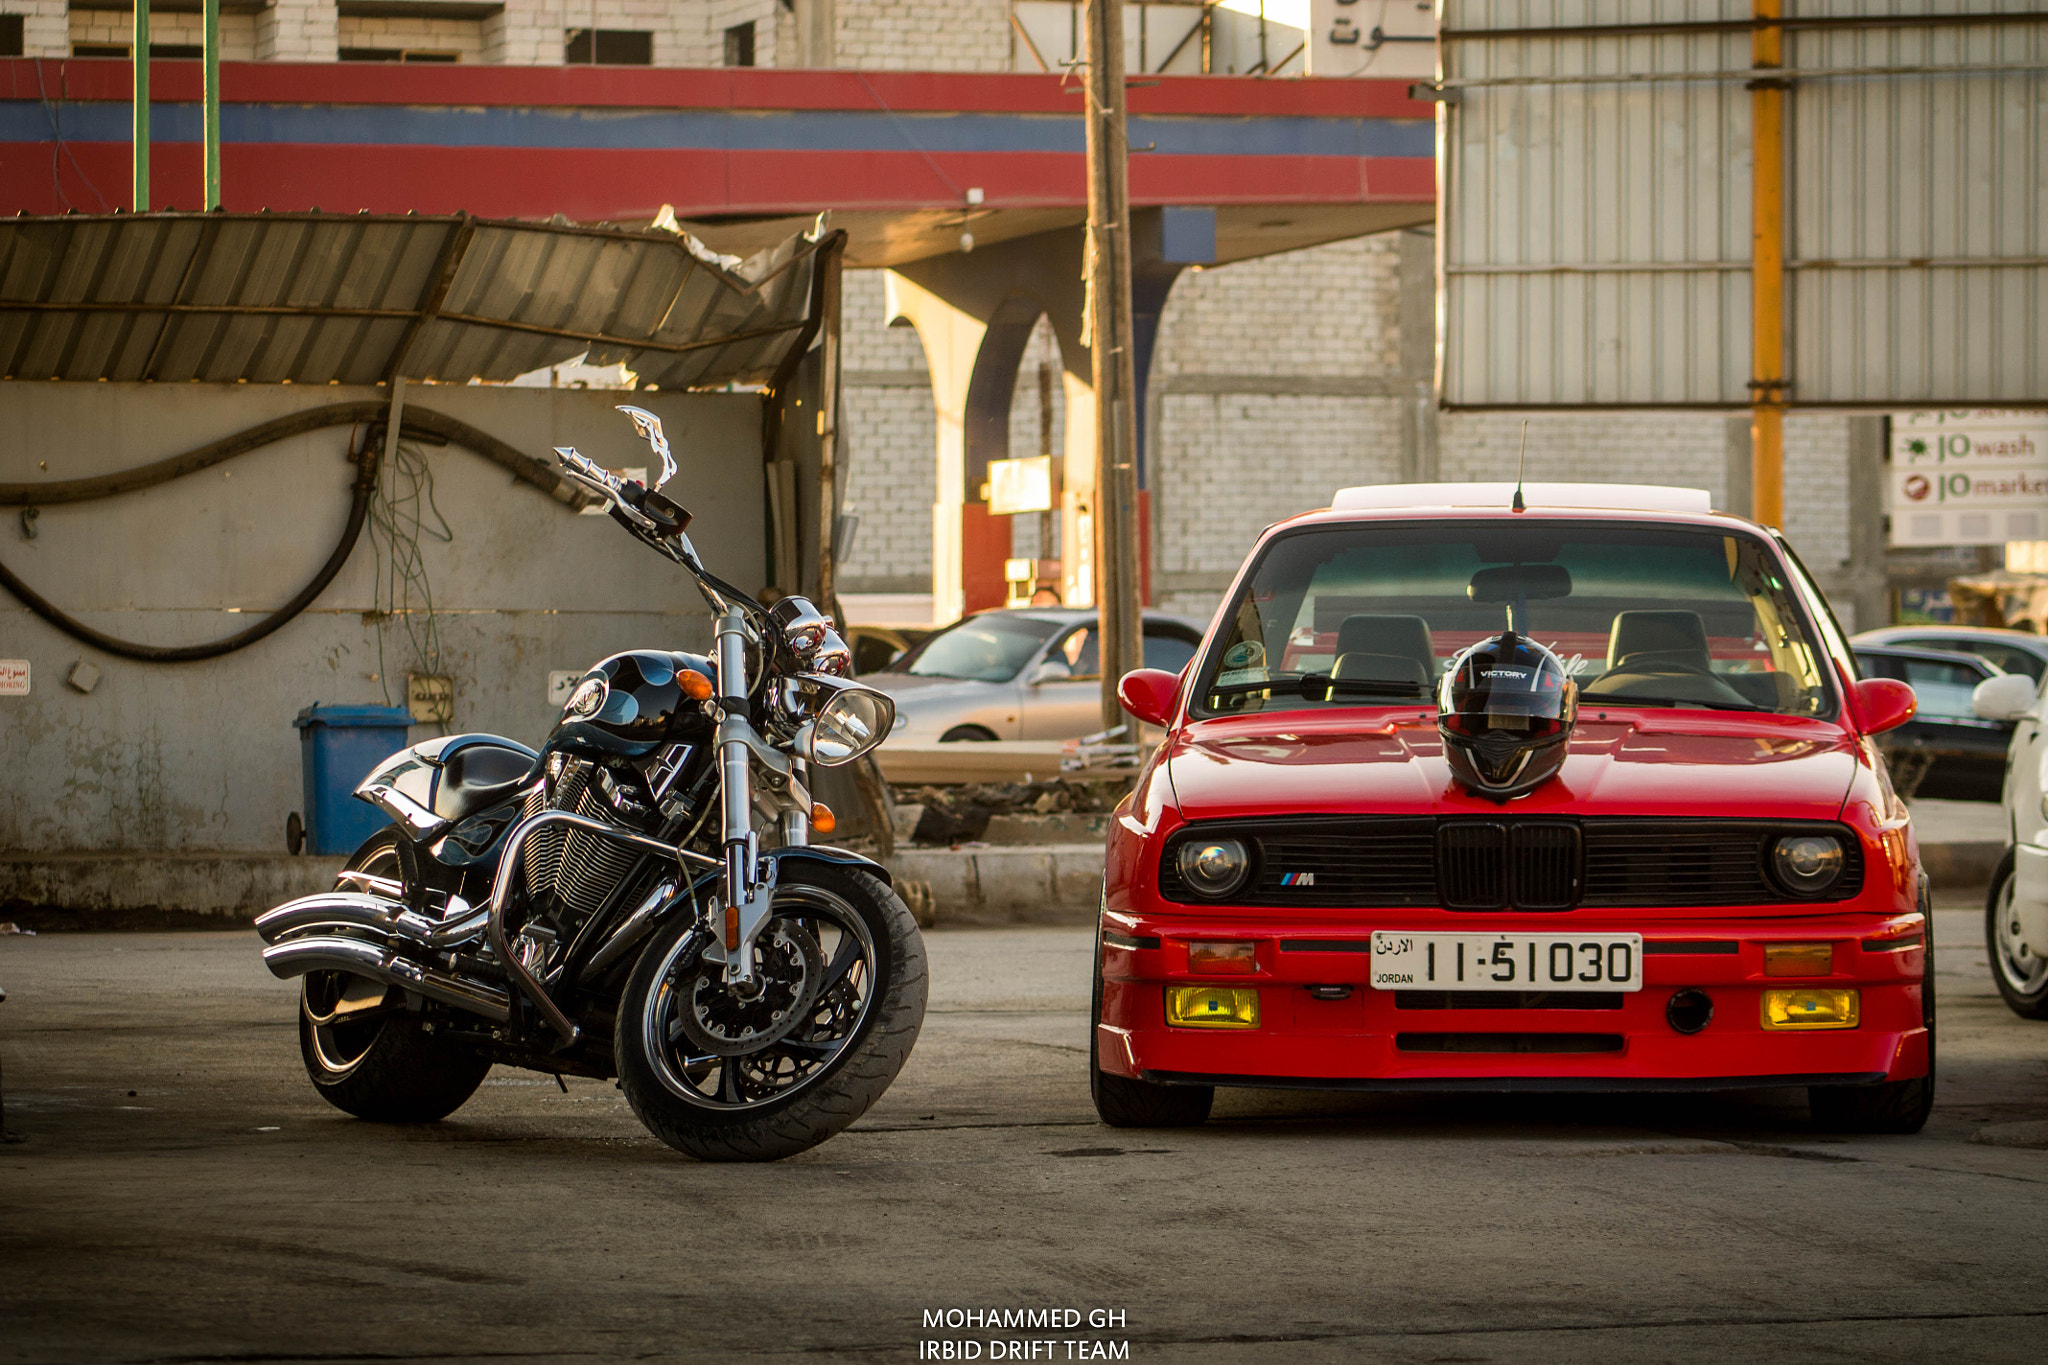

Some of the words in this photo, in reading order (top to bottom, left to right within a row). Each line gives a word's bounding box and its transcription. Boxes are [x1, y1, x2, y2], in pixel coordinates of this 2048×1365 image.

[1938, 433, 1970, 464] JO
[1974, 434, 2035, 456] wash
[1938, 472, 1970, 503] JO
[1480, 670, 1527, 679] VICTORY
[1295, 872, 1314, 886] M
[1376, 973, 1414, 984] JORDAN
